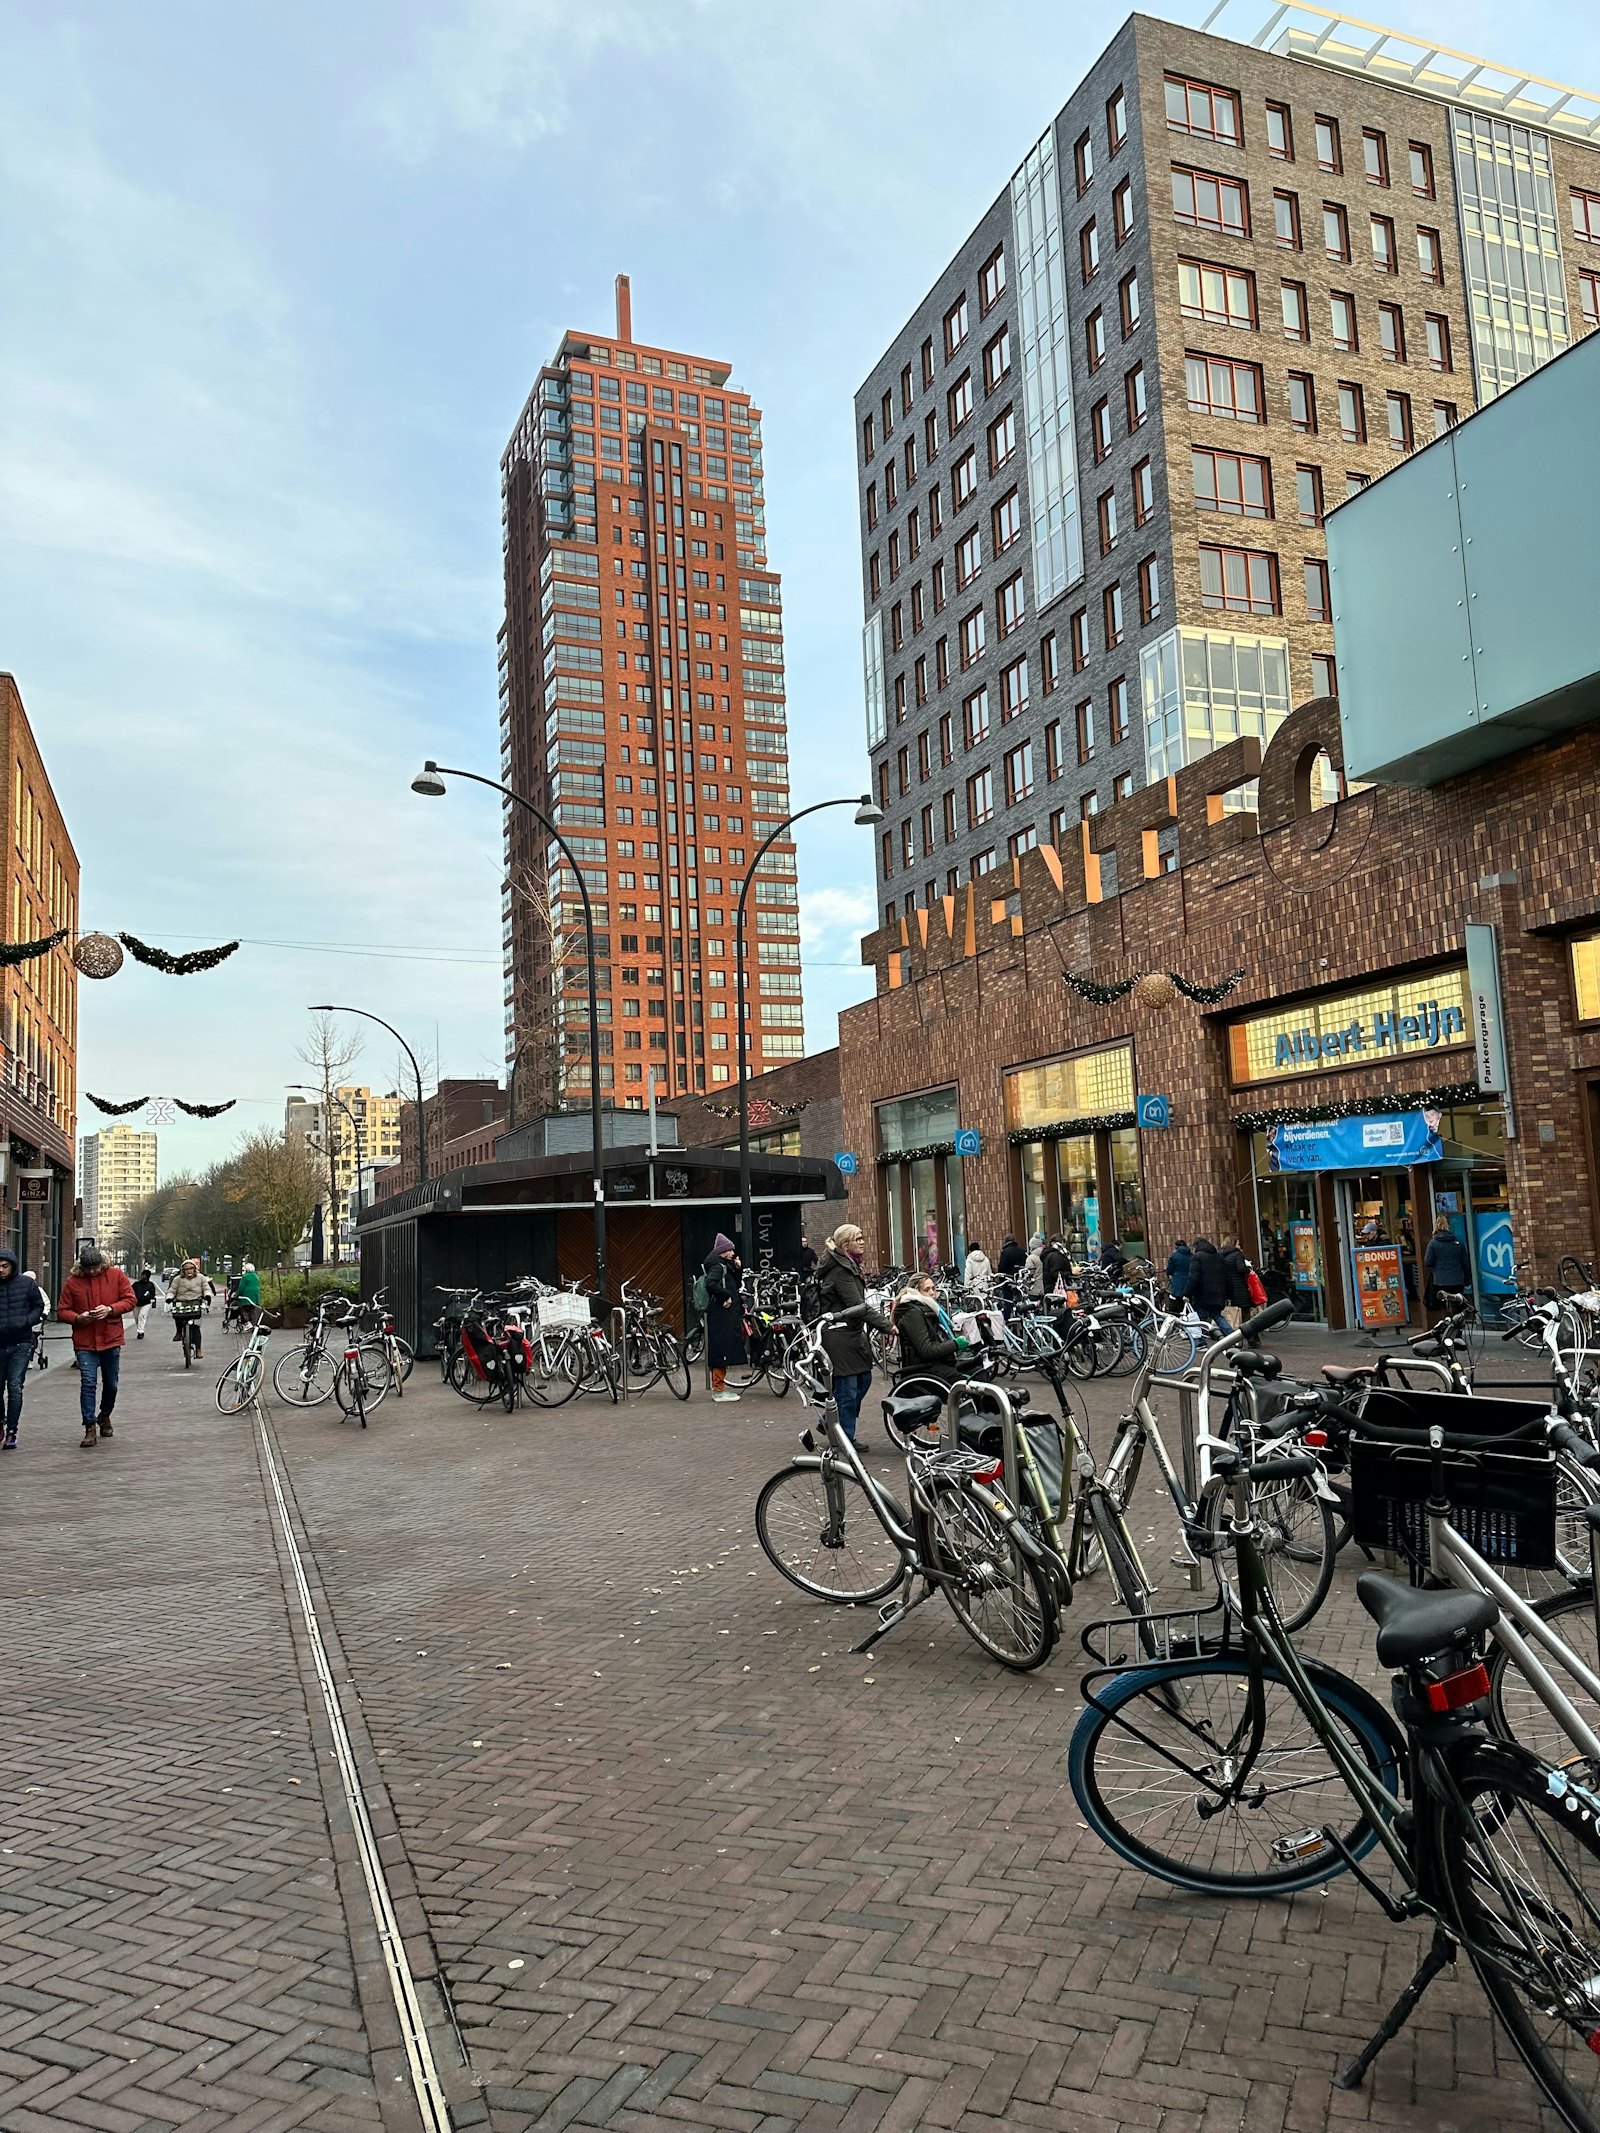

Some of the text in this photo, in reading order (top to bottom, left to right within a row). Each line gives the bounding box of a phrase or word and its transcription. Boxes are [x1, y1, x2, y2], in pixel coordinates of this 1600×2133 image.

[1275, 1000, 1463, 1067] Albert Heijn
[1478, 995, 1492, 1084] Parkeergarage
[1283, 1129, 1331, 1143] bijverdienen.
[1285, 1142, 1308, 1152] Maak
[1285, 1153, 1322, 1163] werk van.
[758, 1213, 773, 1242] Uw
[1364, 1250, 1397, 1262] BONUS
